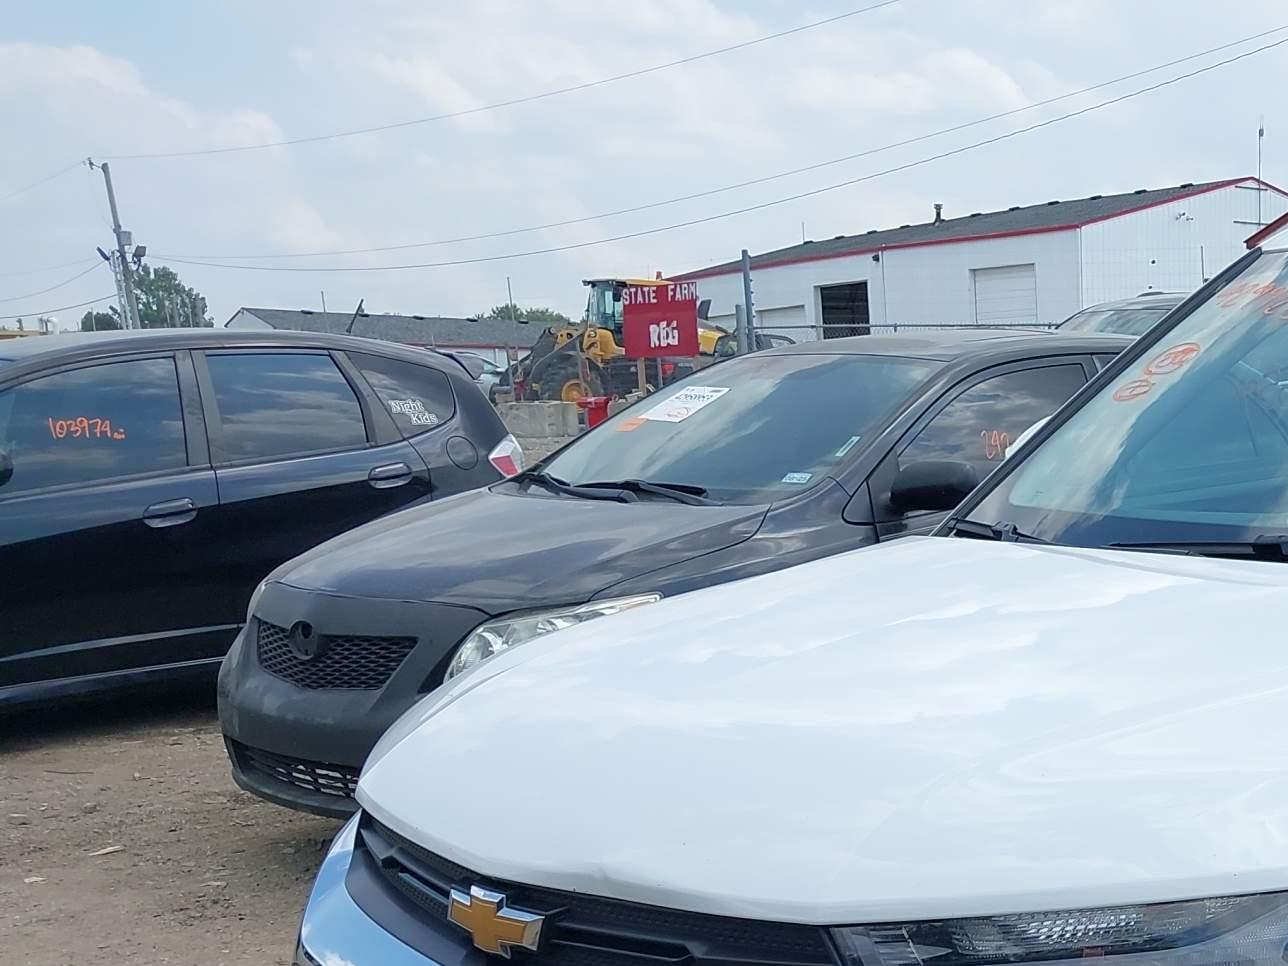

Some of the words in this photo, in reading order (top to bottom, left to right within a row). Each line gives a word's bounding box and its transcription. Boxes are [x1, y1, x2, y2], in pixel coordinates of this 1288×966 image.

[623, 286, 657, 305] STATE
[667, 283, 697, 302] FARM
[389, 398, 425, 414] Night
[411, 410, 439, 425] Kids
